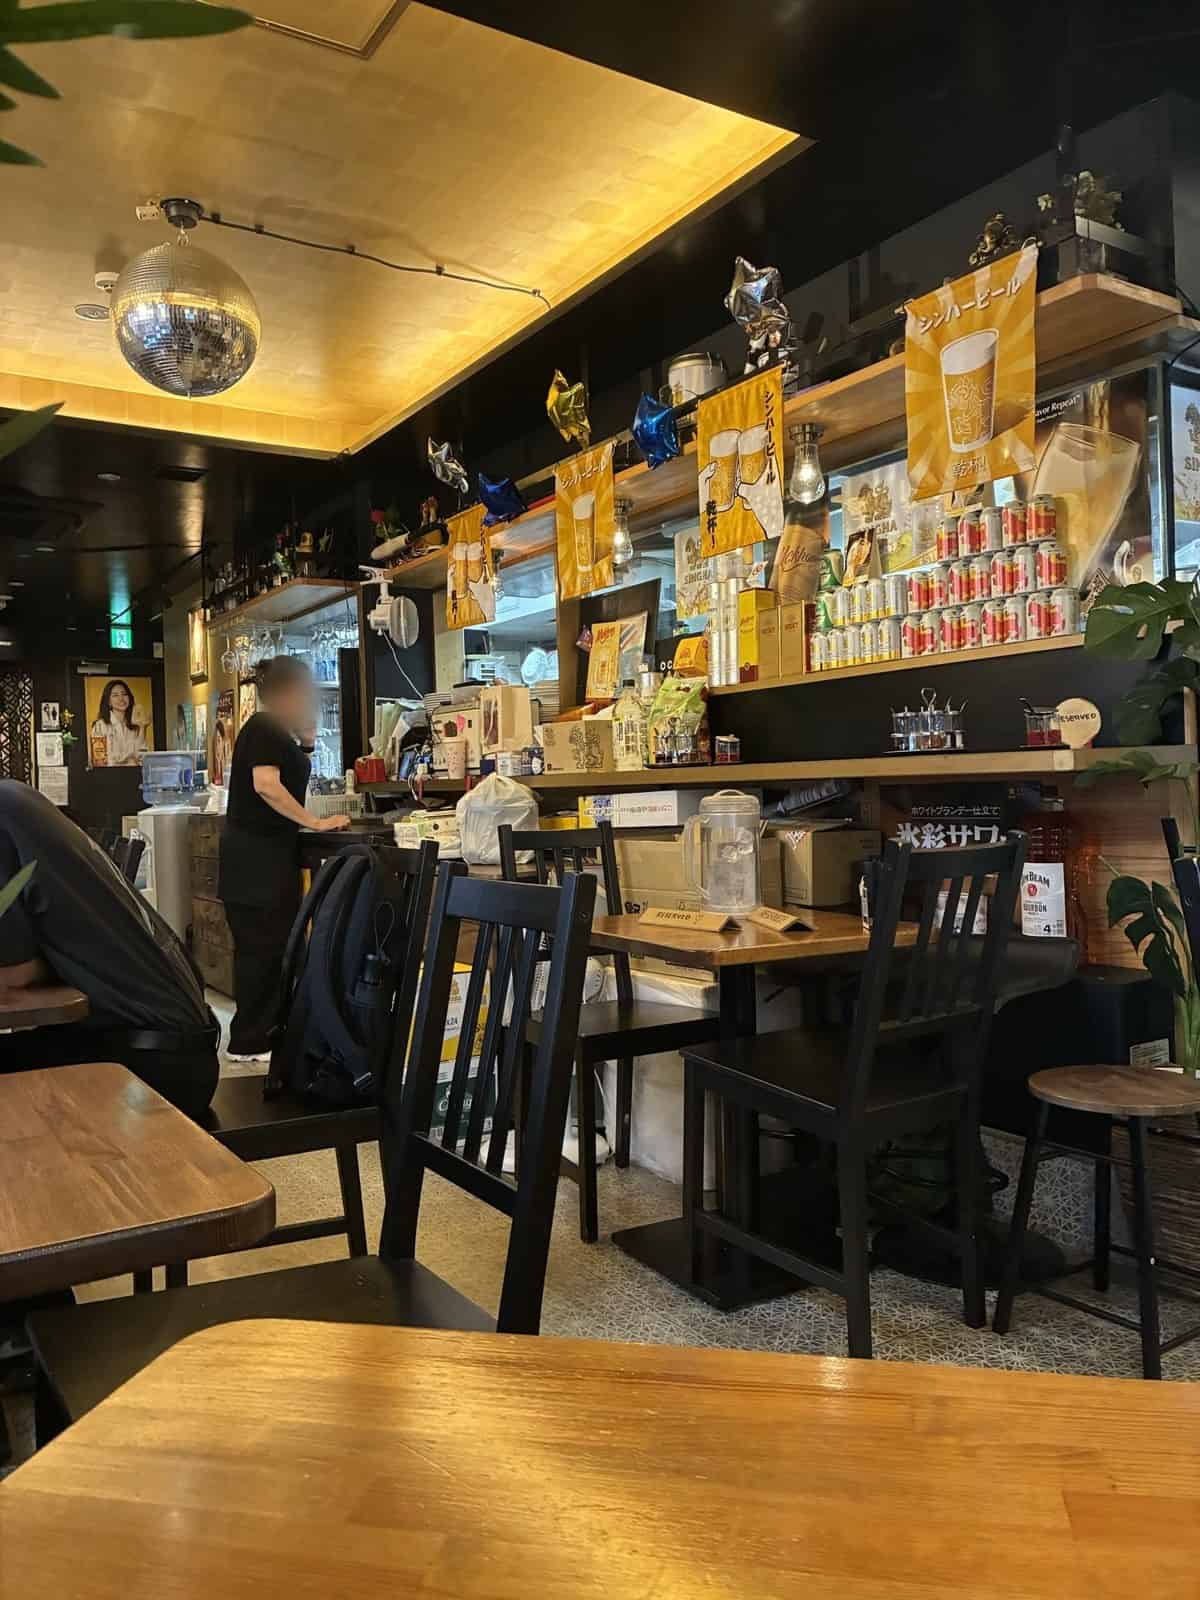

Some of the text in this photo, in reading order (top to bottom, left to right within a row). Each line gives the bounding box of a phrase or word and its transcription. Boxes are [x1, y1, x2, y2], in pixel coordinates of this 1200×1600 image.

[919, 280, 1021, 335] シンハービール
[764, 391, 776, 485] シンハービール
[1060, 712, 1097, 723] ESERVED
[896, 822, 1007, 849] 氷彩サワ
